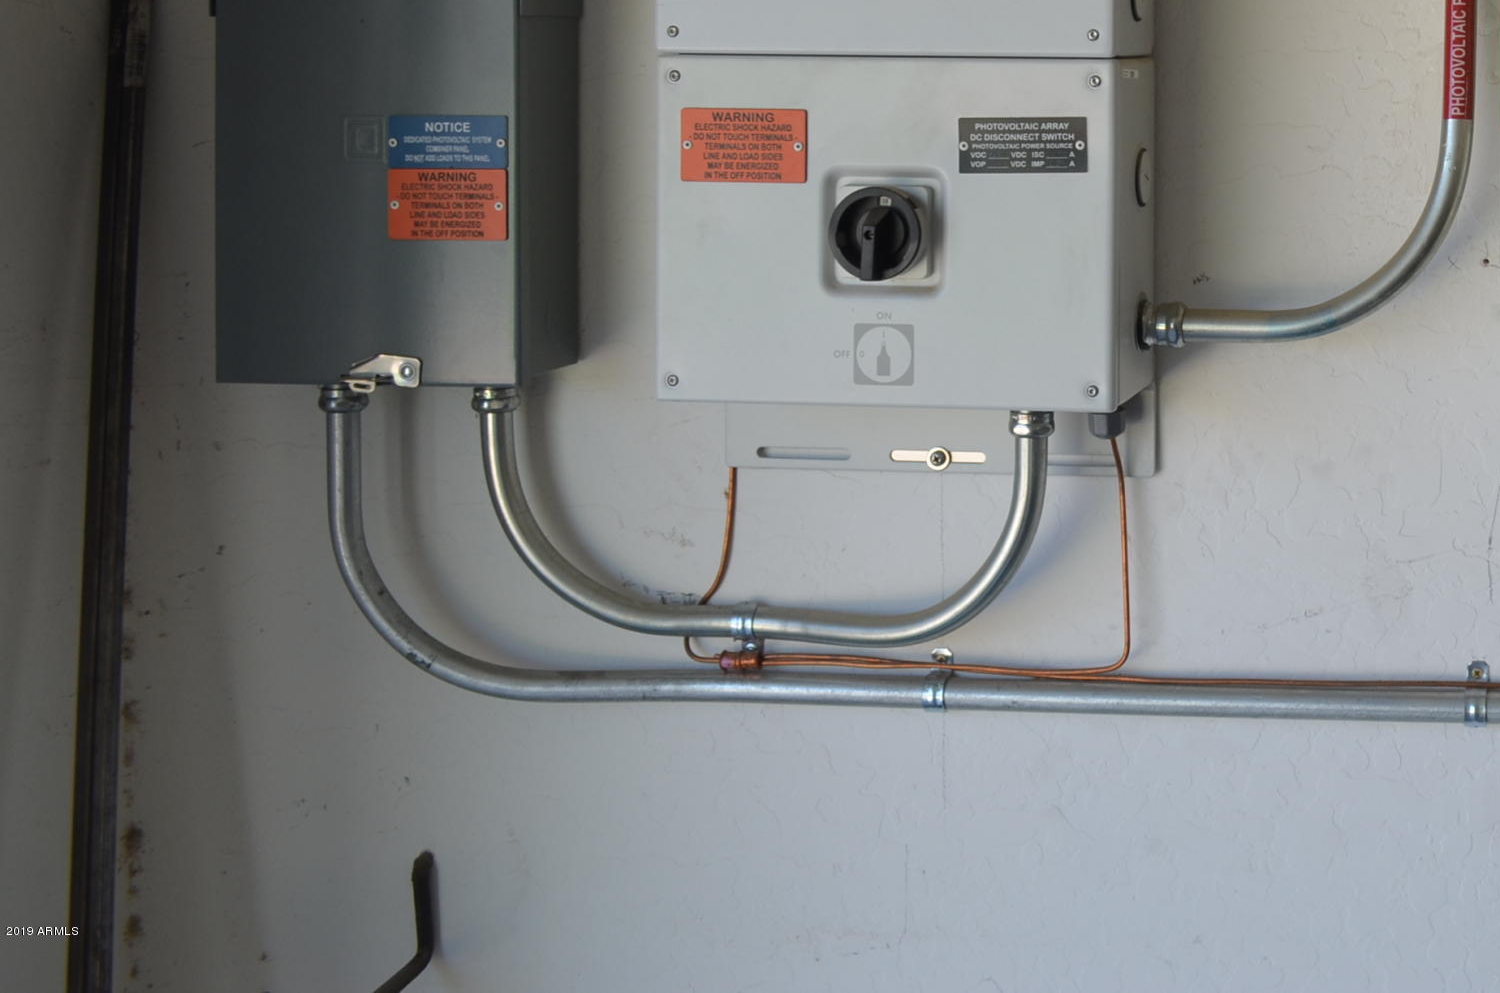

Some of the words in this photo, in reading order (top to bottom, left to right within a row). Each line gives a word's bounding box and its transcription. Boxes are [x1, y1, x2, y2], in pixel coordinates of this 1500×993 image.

[1451, 10, 1466, 116] PHOTOVOLTAIC
[712, 112, 774, 122] WARNING
[425, 122, 470, 132] NOTICE
[695, 123, 730, 131] ELECTRIC
[761, 124, 792, 132] HAZARD
[418, 173, 476, 182] WARNING
[746, 172, 781, 180] POSITION
[876, 311, 892, 320] ON
[833, 350, 852, 358] OFF
